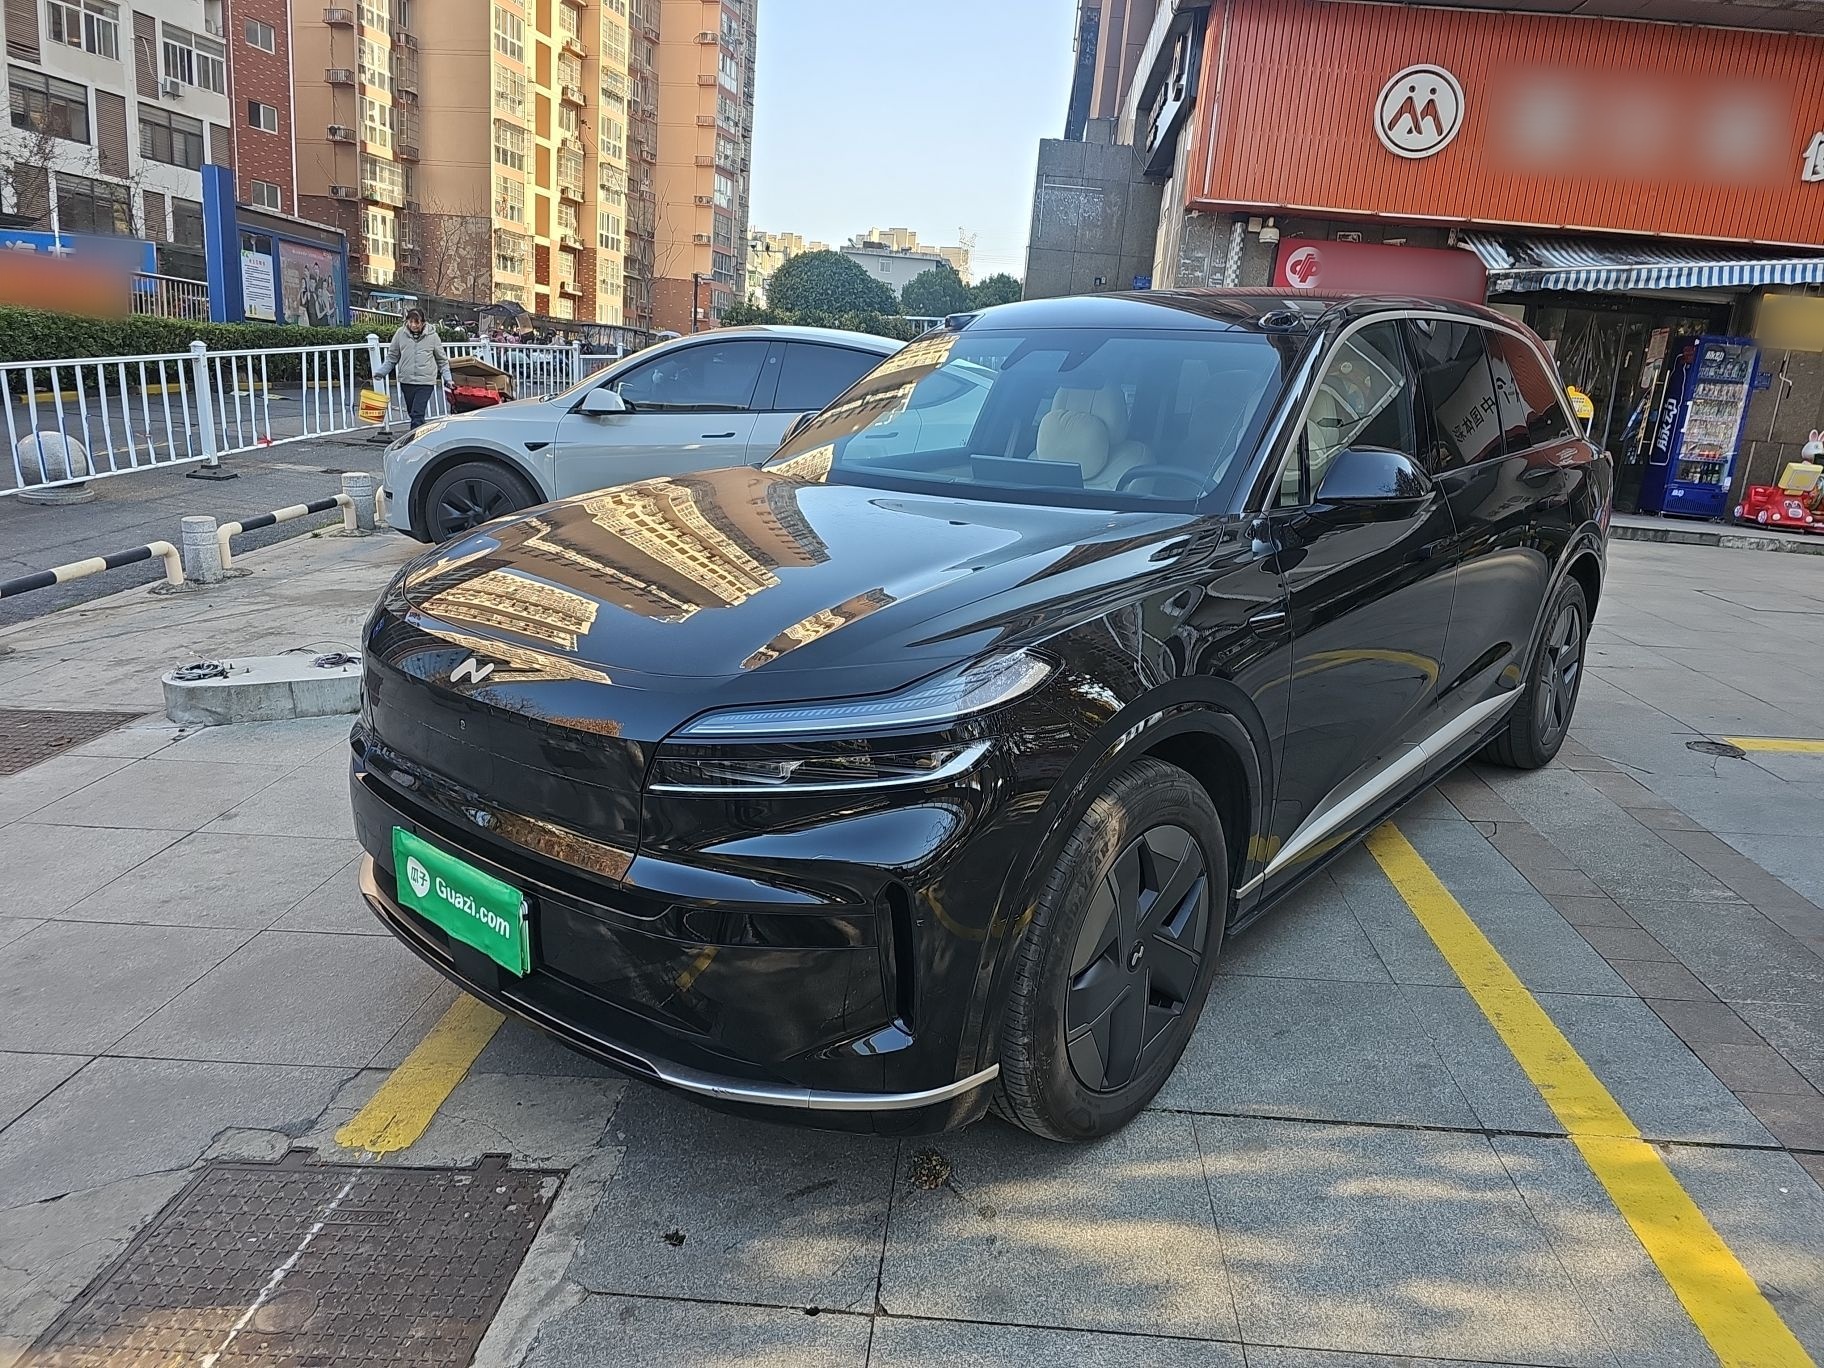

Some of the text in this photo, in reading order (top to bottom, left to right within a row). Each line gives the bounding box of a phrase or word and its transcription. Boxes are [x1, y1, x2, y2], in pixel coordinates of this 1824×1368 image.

[1656, 398, 1678, 452] 脉动
[410, 866, 428, 887] 瓜子
[435, 876, 510, 939] Guazi.com
